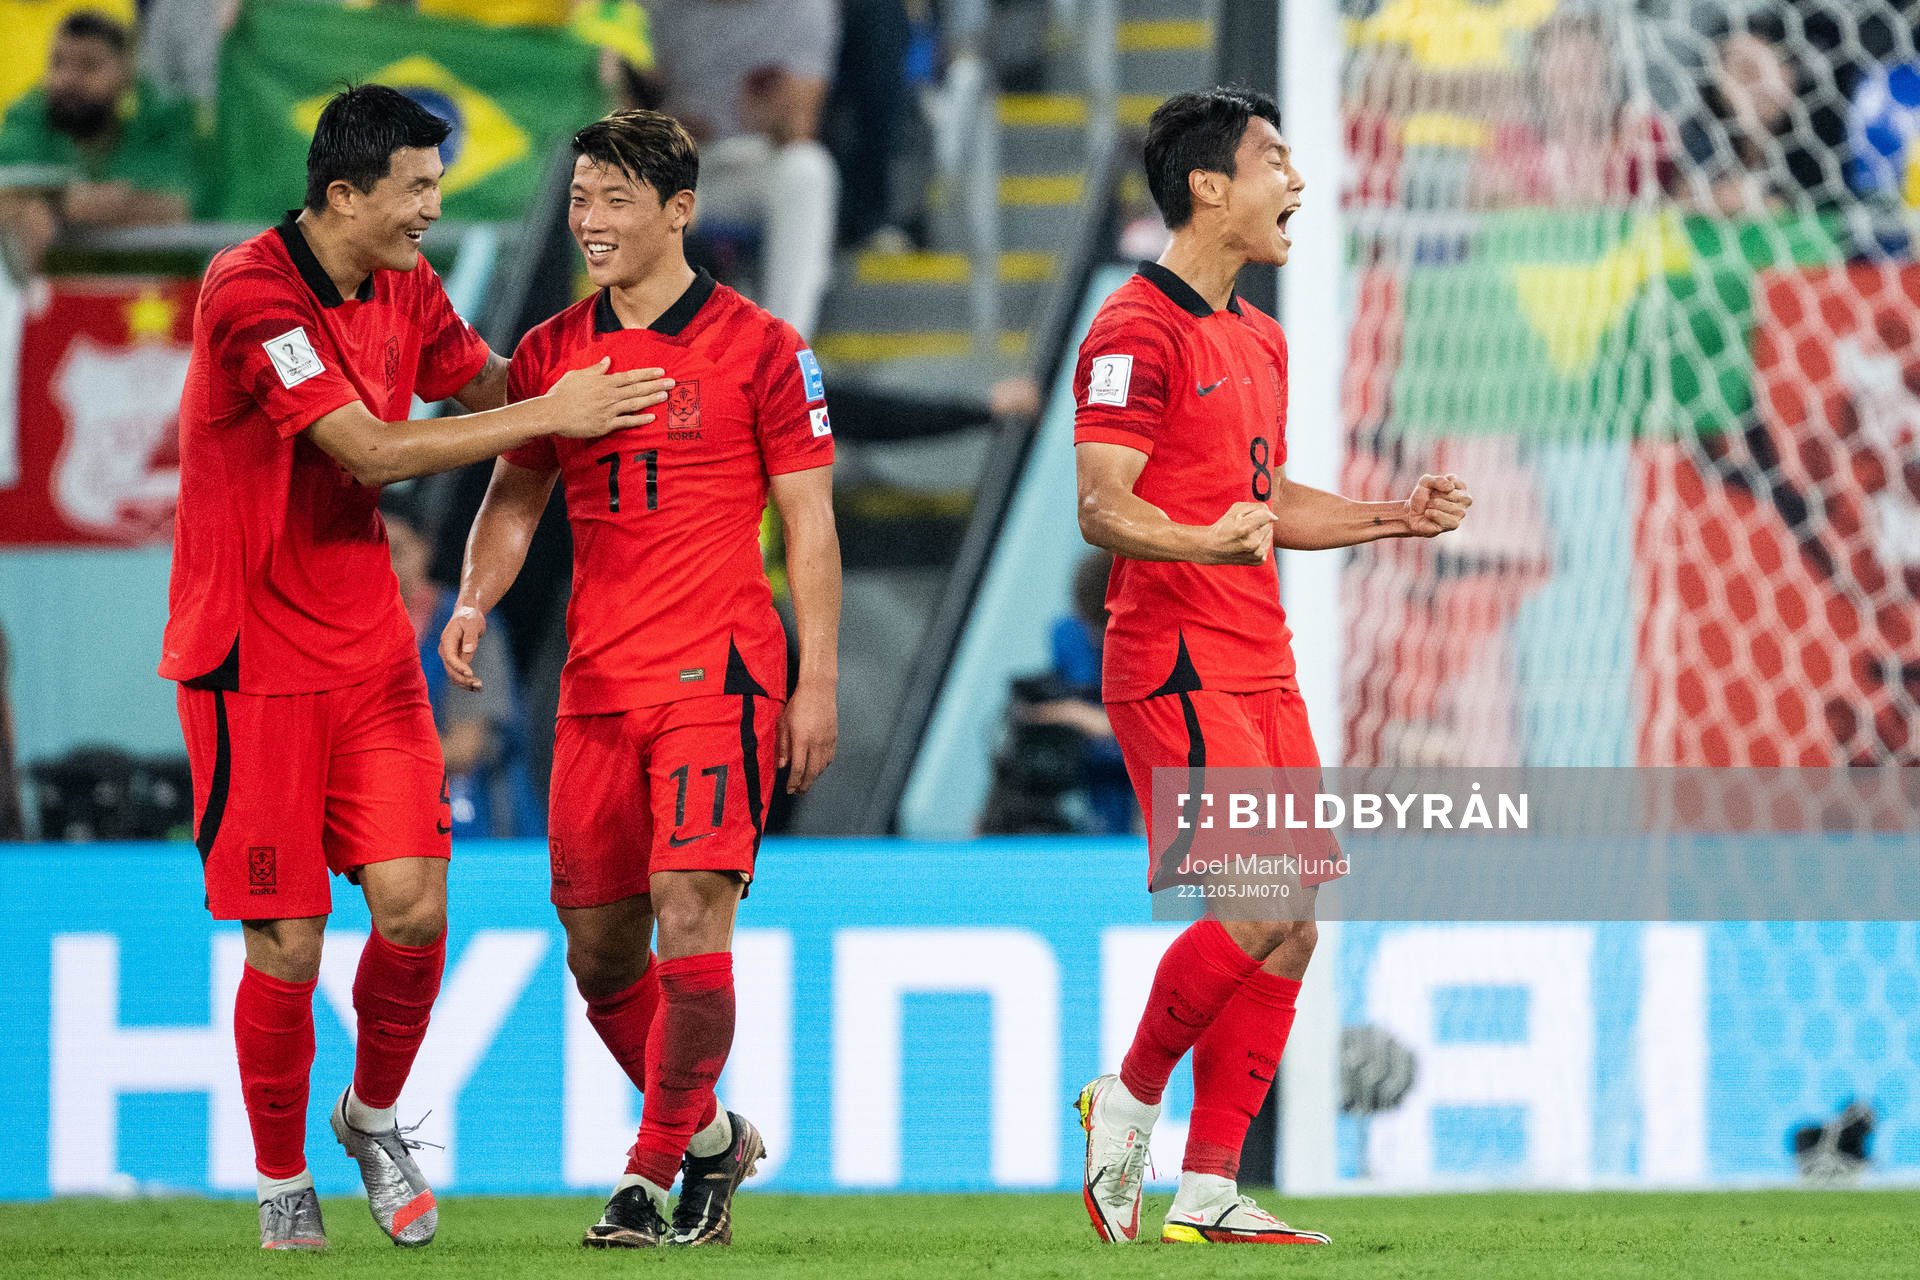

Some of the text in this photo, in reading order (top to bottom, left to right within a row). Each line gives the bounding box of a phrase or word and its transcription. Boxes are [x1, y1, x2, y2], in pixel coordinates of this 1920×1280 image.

[667, 430, 703, 441] KOREA
[597, 449, 658, 513] 11
[1249, 436, 1272, 502] 8
[669, 763, 729, 828] 11
